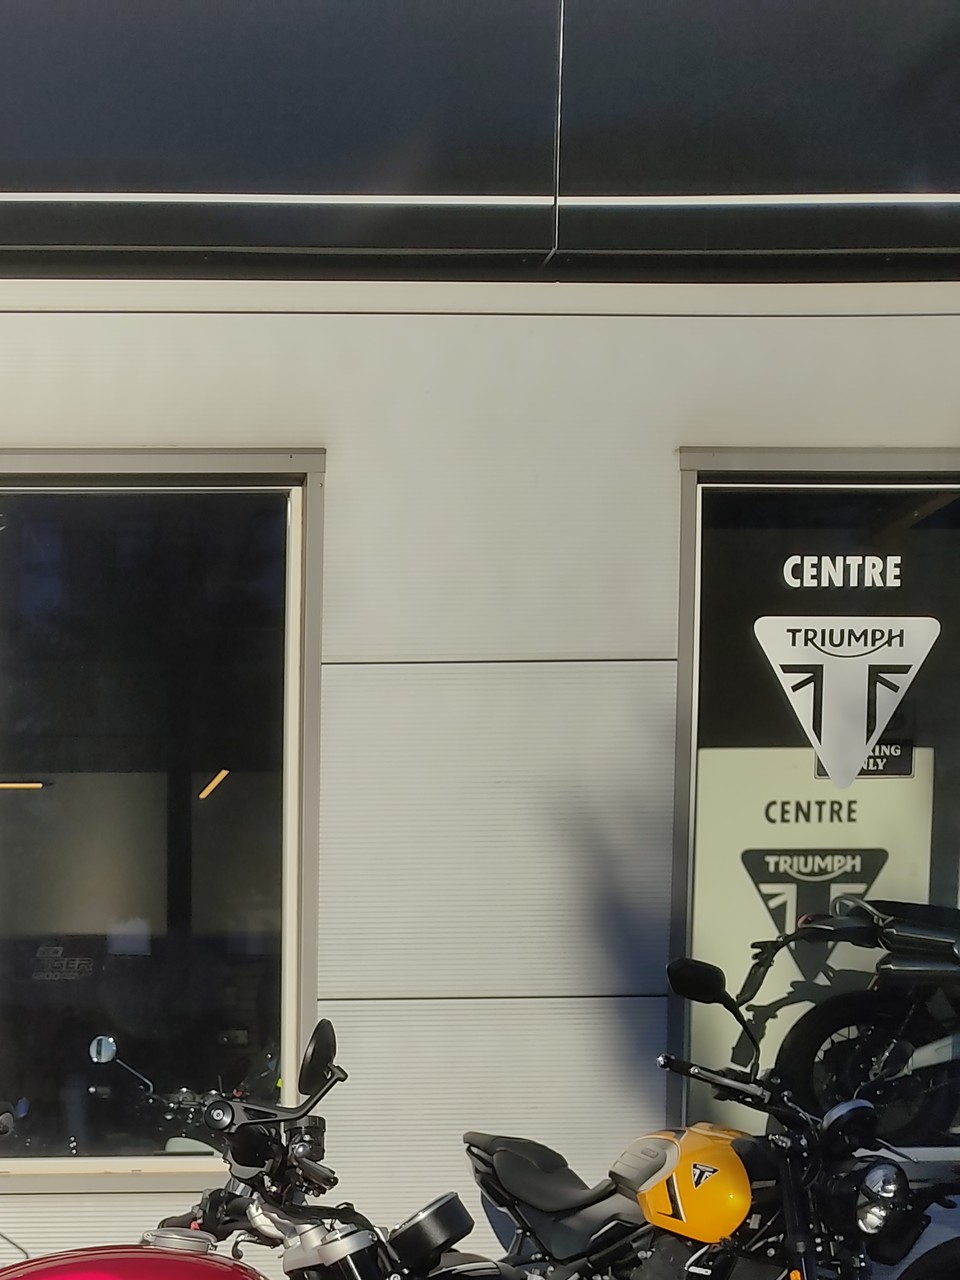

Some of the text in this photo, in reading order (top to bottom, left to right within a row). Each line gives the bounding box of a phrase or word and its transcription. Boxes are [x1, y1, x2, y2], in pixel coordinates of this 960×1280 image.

[782, 555, 903, 588] CENTRE
[786, 628, 905, 657] TRIUMPH
[764, 800, 858, 824] CENTRE
[764, 855, 862, 881] TRIUMPH
